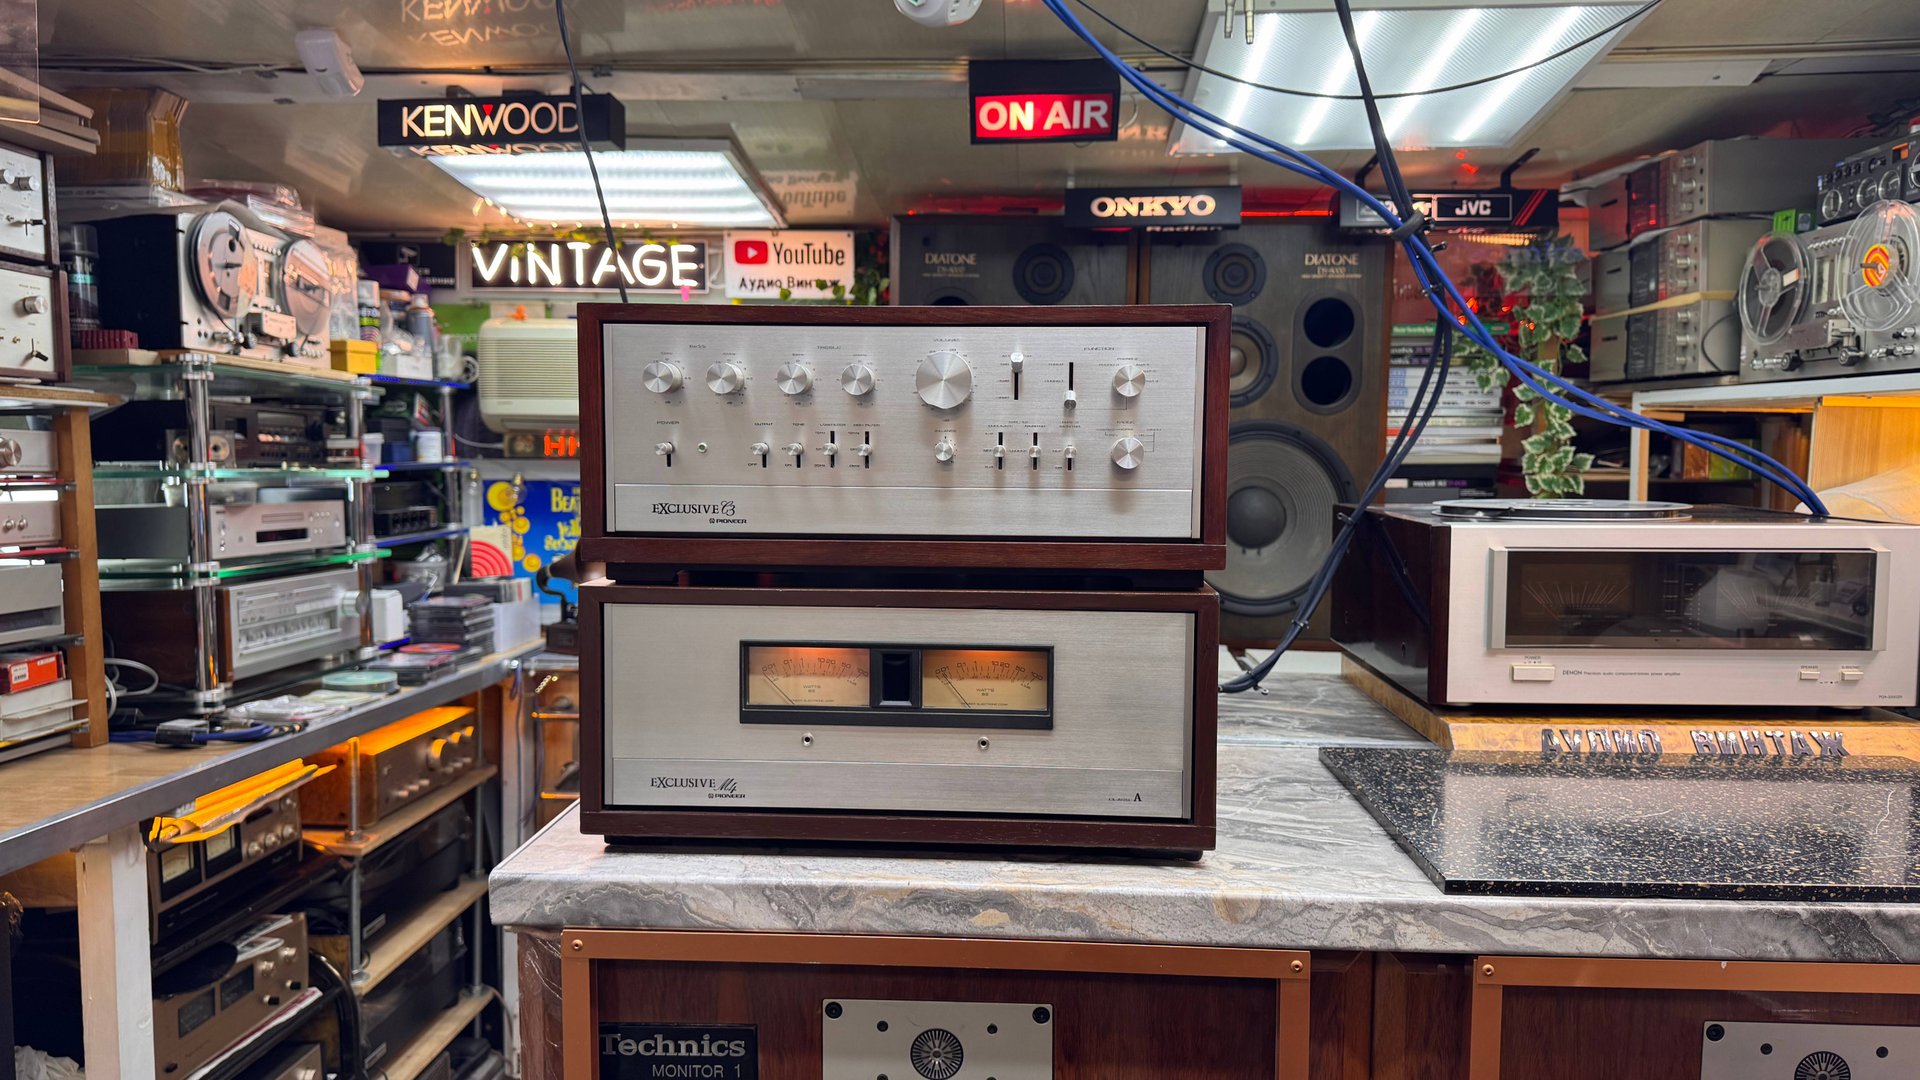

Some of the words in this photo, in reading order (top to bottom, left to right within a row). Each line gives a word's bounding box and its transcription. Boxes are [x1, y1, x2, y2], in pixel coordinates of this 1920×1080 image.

[402, 102, 579, 137] KENWOOD
[979, 102, 1034, 131] ON
[1043, 101, 1109, 129] AIR
[1090, 194, 1216, 217] ONKYO
[773, 242, 846, 266] YouTube
[925, 253, 977, 265] DIATONE
[1305, 253, 1359, 266] DIATONE
[739, 277, 782, 291] Аудио
[652, 503, 719, 514] EXCLUSIVE
[1690, 729, 1850, 756] ВИНТАЖ
[650, 777, 716, 788] EXCLUSIVE
[1134, 793, 1141, 802] A
[600, 1033, 746, 1057] Technics
[652, 1064, 724, 1078] MONITOR
[734, 1064, 741, 1078] 1
